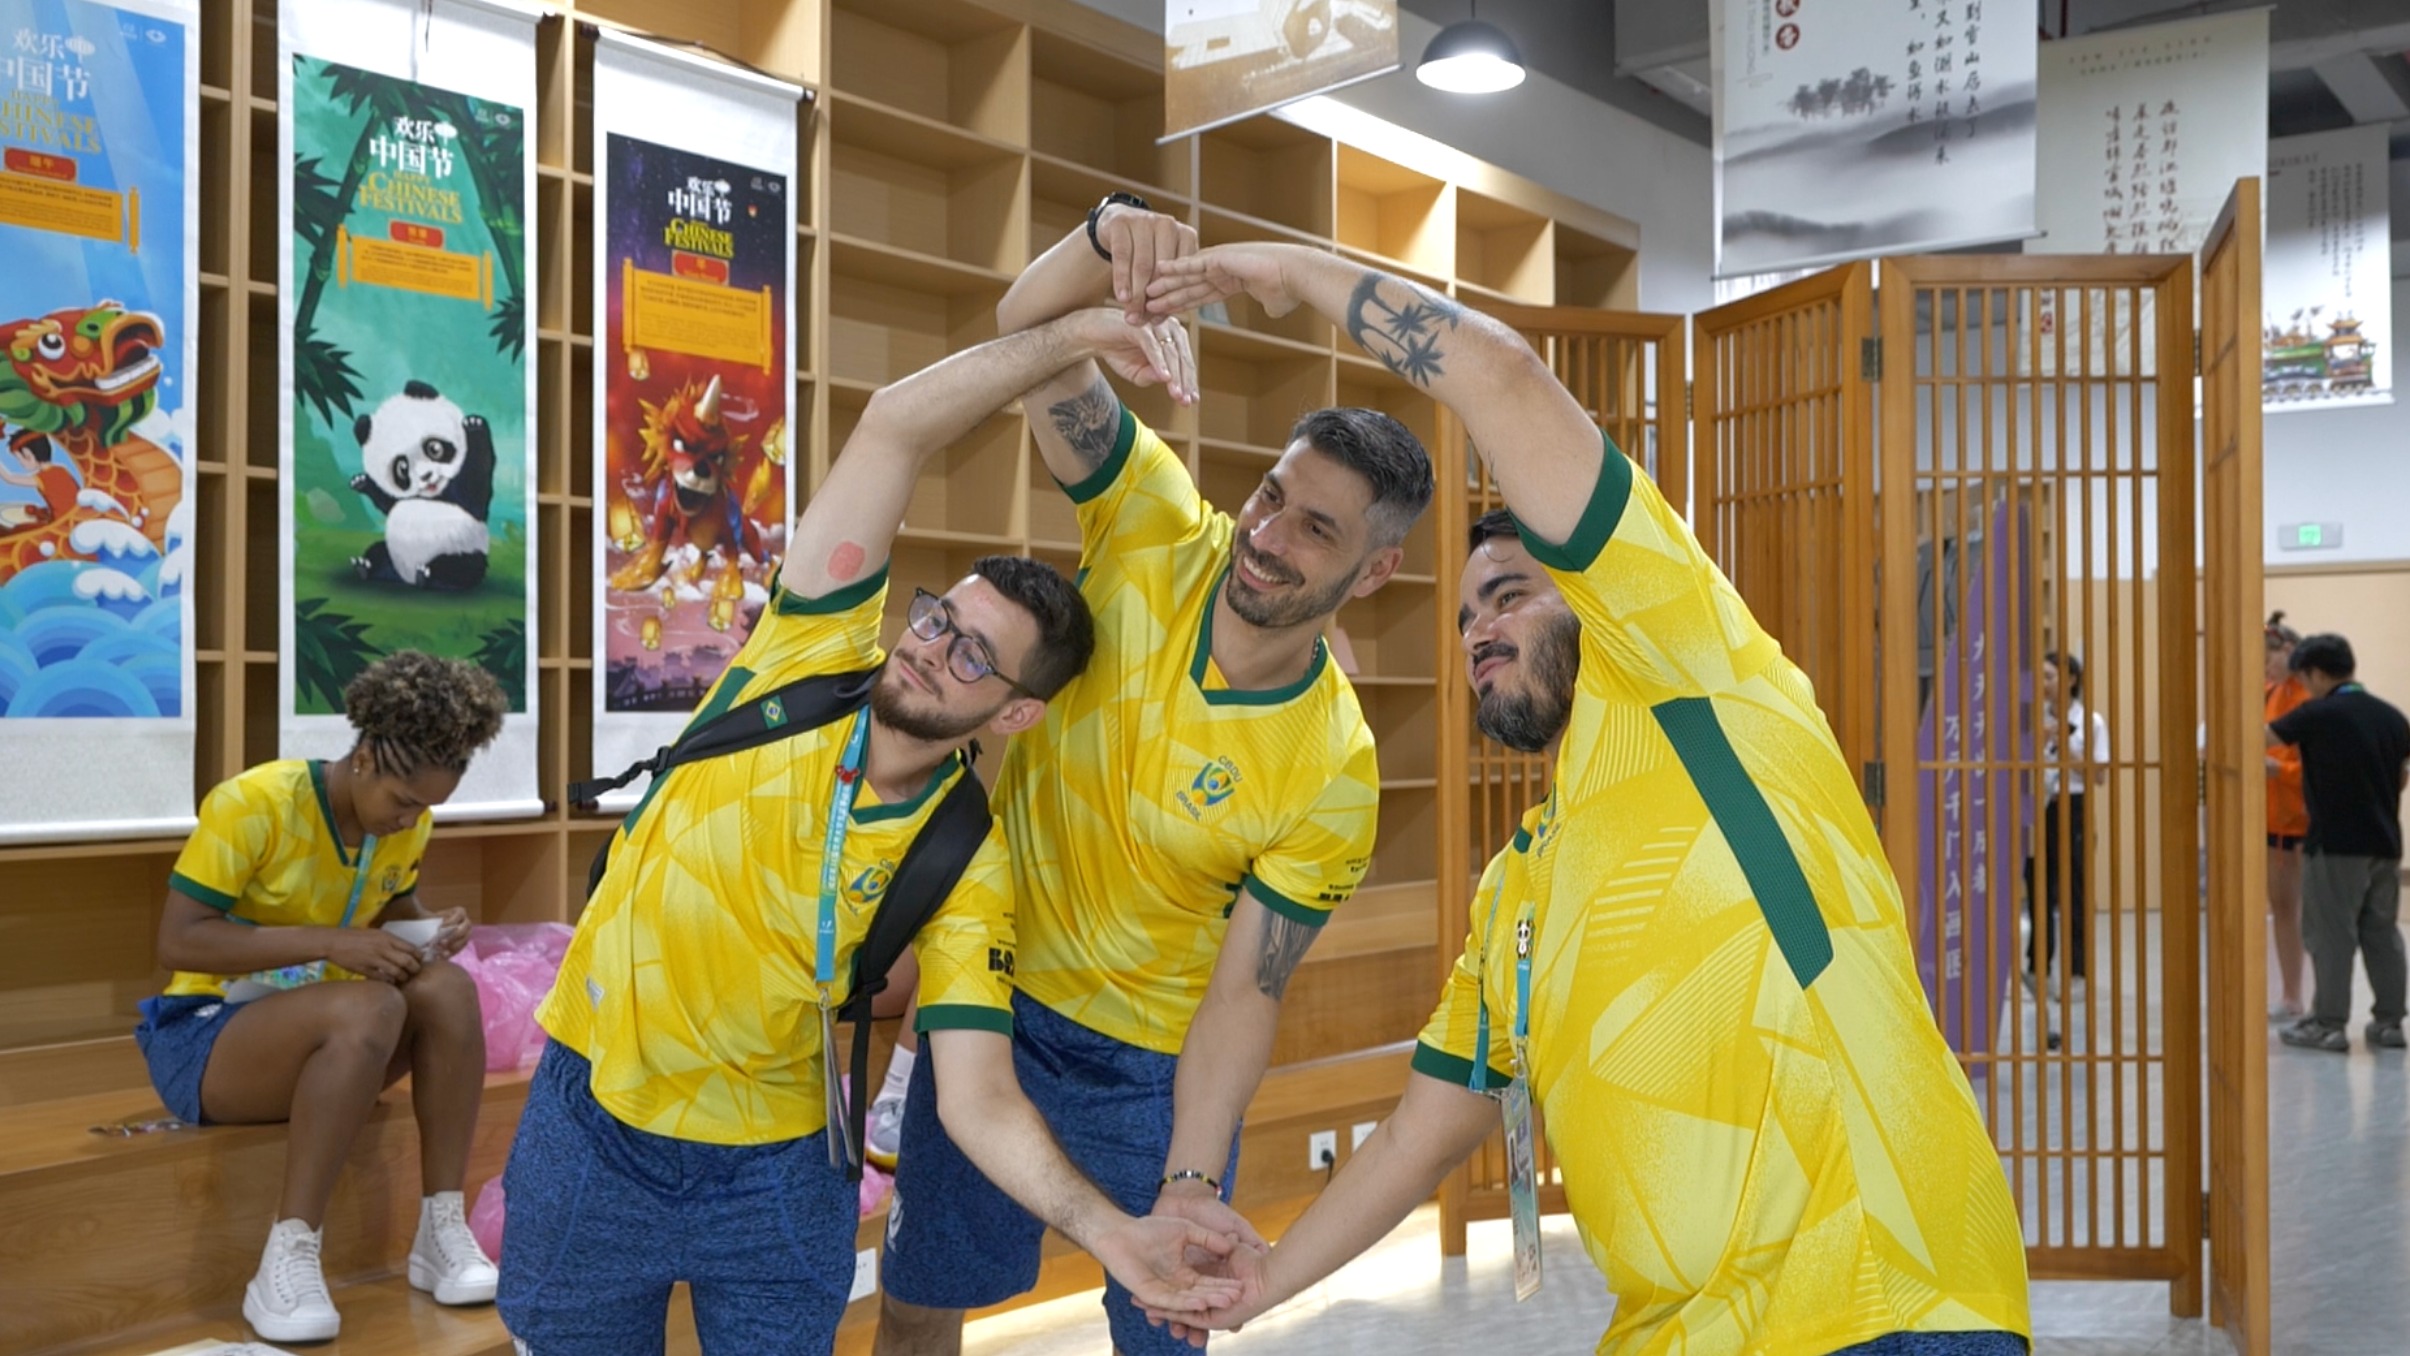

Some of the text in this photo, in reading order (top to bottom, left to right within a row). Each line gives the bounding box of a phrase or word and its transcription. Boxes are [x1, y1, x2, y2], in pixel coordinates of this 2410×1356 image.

[12, 27, 66, 60] 欢乐
[394, 116, 435, 144] 欢乐
[369, 135, 454, 179] 中国节
[358, 184, 463, 223] FESTIVALS
[368, 172, 460, 206] CHINESE
[668, 187, 732, 224] 中国节
[663, 226, 735, 259] FESTIVALS
[670, 217, 735, 245] CHINESE
[1217, 755, 1244, 783] CBDU
[1175, 789, 1202, 822] BRASIL
